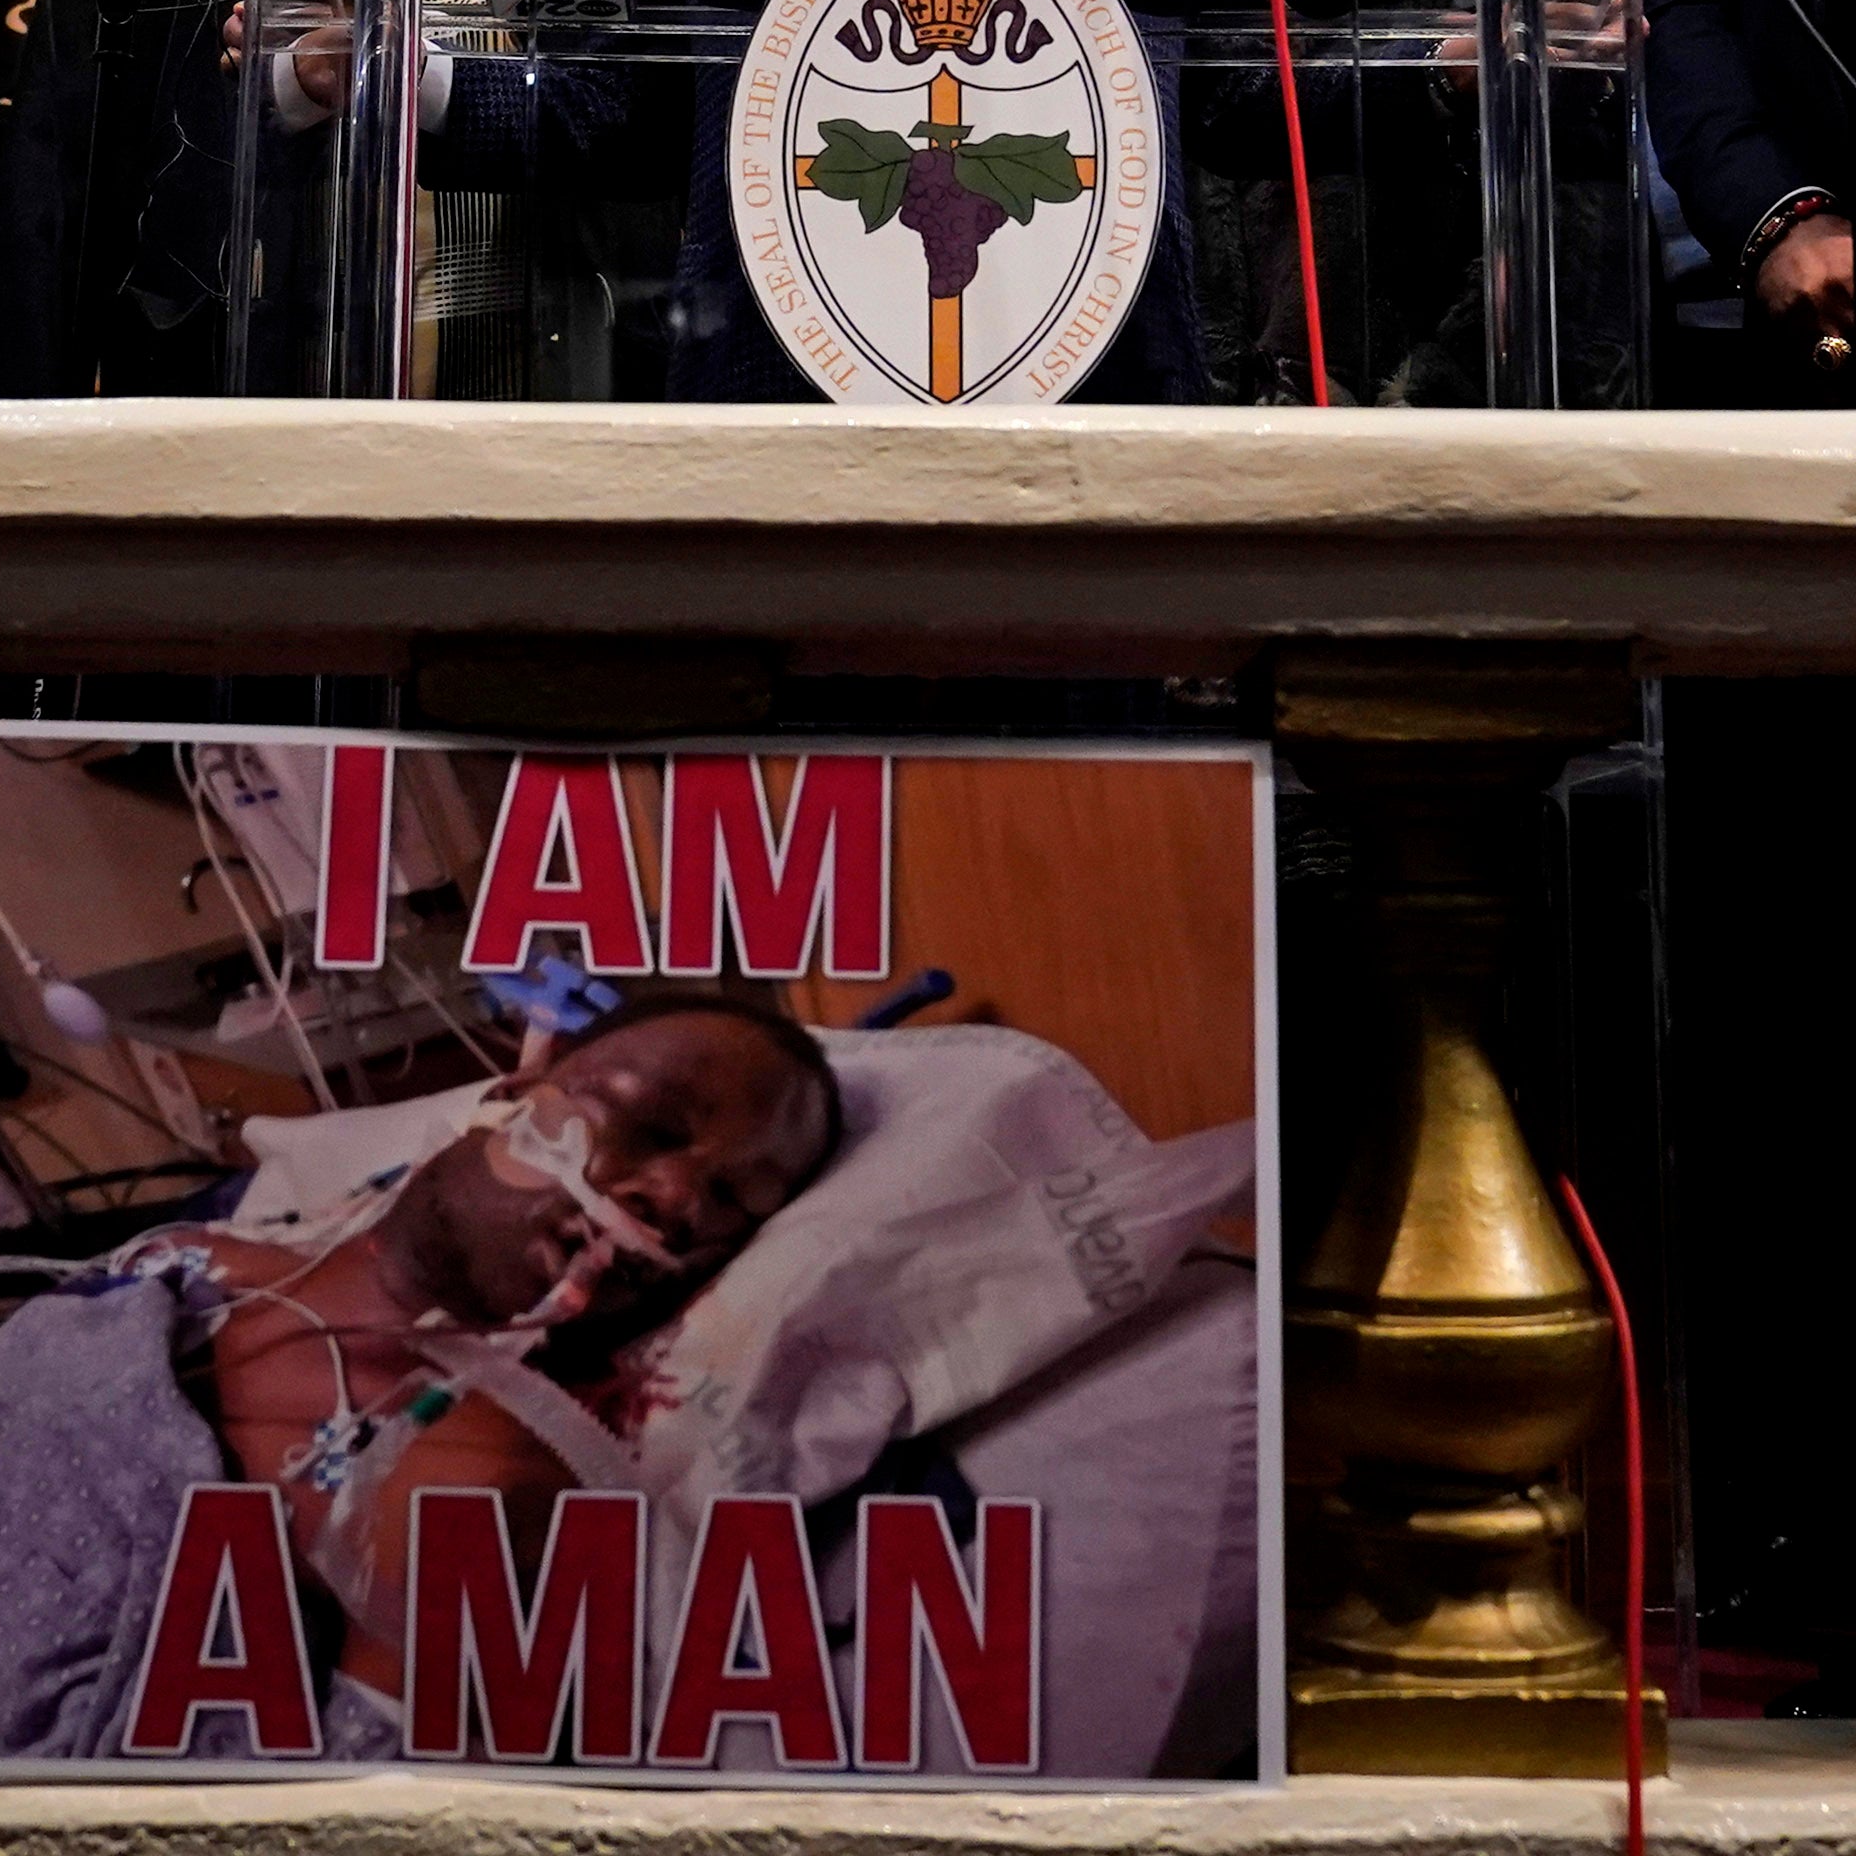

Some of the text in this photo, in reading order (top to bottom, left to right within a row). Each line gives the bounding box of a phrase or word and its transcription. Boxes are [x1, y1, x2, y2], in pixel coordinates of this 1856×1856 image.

[743, 67, 782, 149] THE
[1109, 65, 1145, 116] OF
[744, 157, 773, 210] OF
[1117, 127, 1149, 210] GOD
[751, 217, 808, 315] SEAL
[1108, 222, 1142, 266] IN
[794, 316, 860, 394] THE
[1024, 271, 1124, 400] CHRIST
[313, 743, 893, 978] I AM
[121, 1481, 1042, 1772] A MAN
